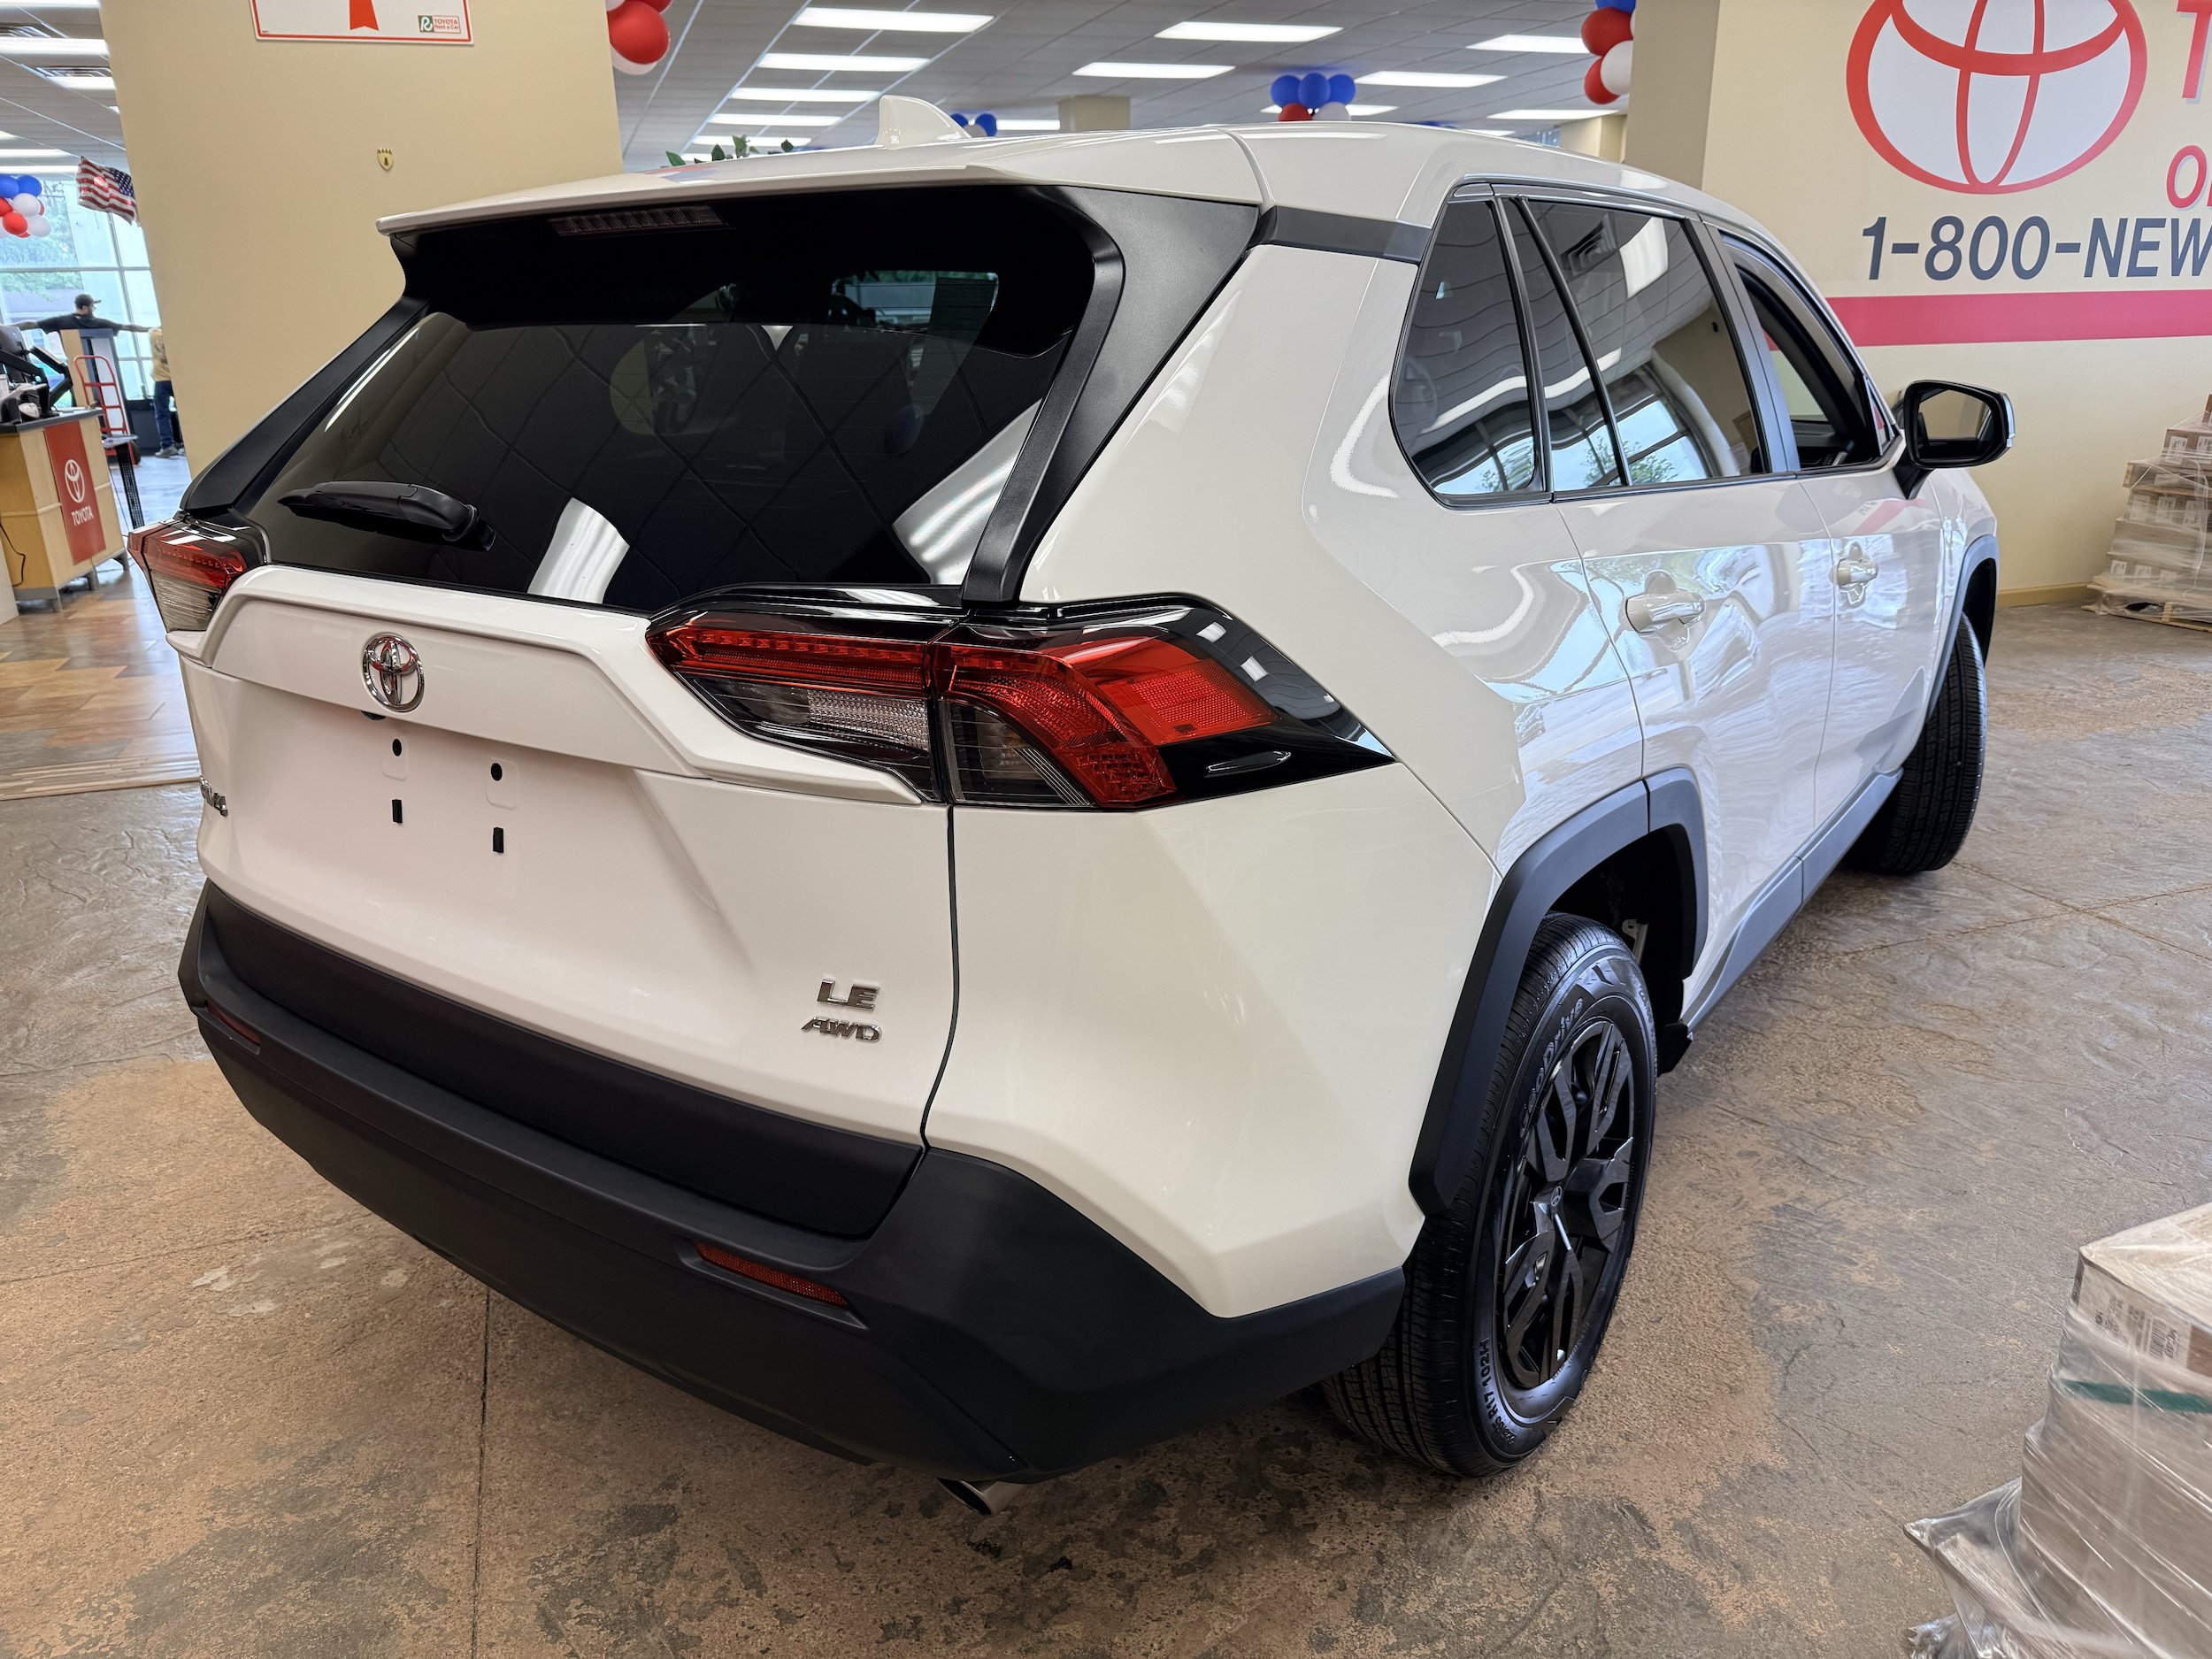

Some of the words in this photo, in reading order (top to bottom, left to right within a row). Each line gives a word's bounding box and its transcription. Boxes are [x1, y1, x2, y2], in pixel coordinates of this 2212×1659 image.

[2166, 144, 2212, 210] O
[1862, 215, 2212, 280] 1-800-NEW
[71, 505, 94, 526] TOYOTA
[817, 978, 880, 1011] LE
[801, 1016, 883, 1043] AWD
[1479, 1337, 1492, 1387] 102H
[1484, 1391, 1498, 1419] R17
